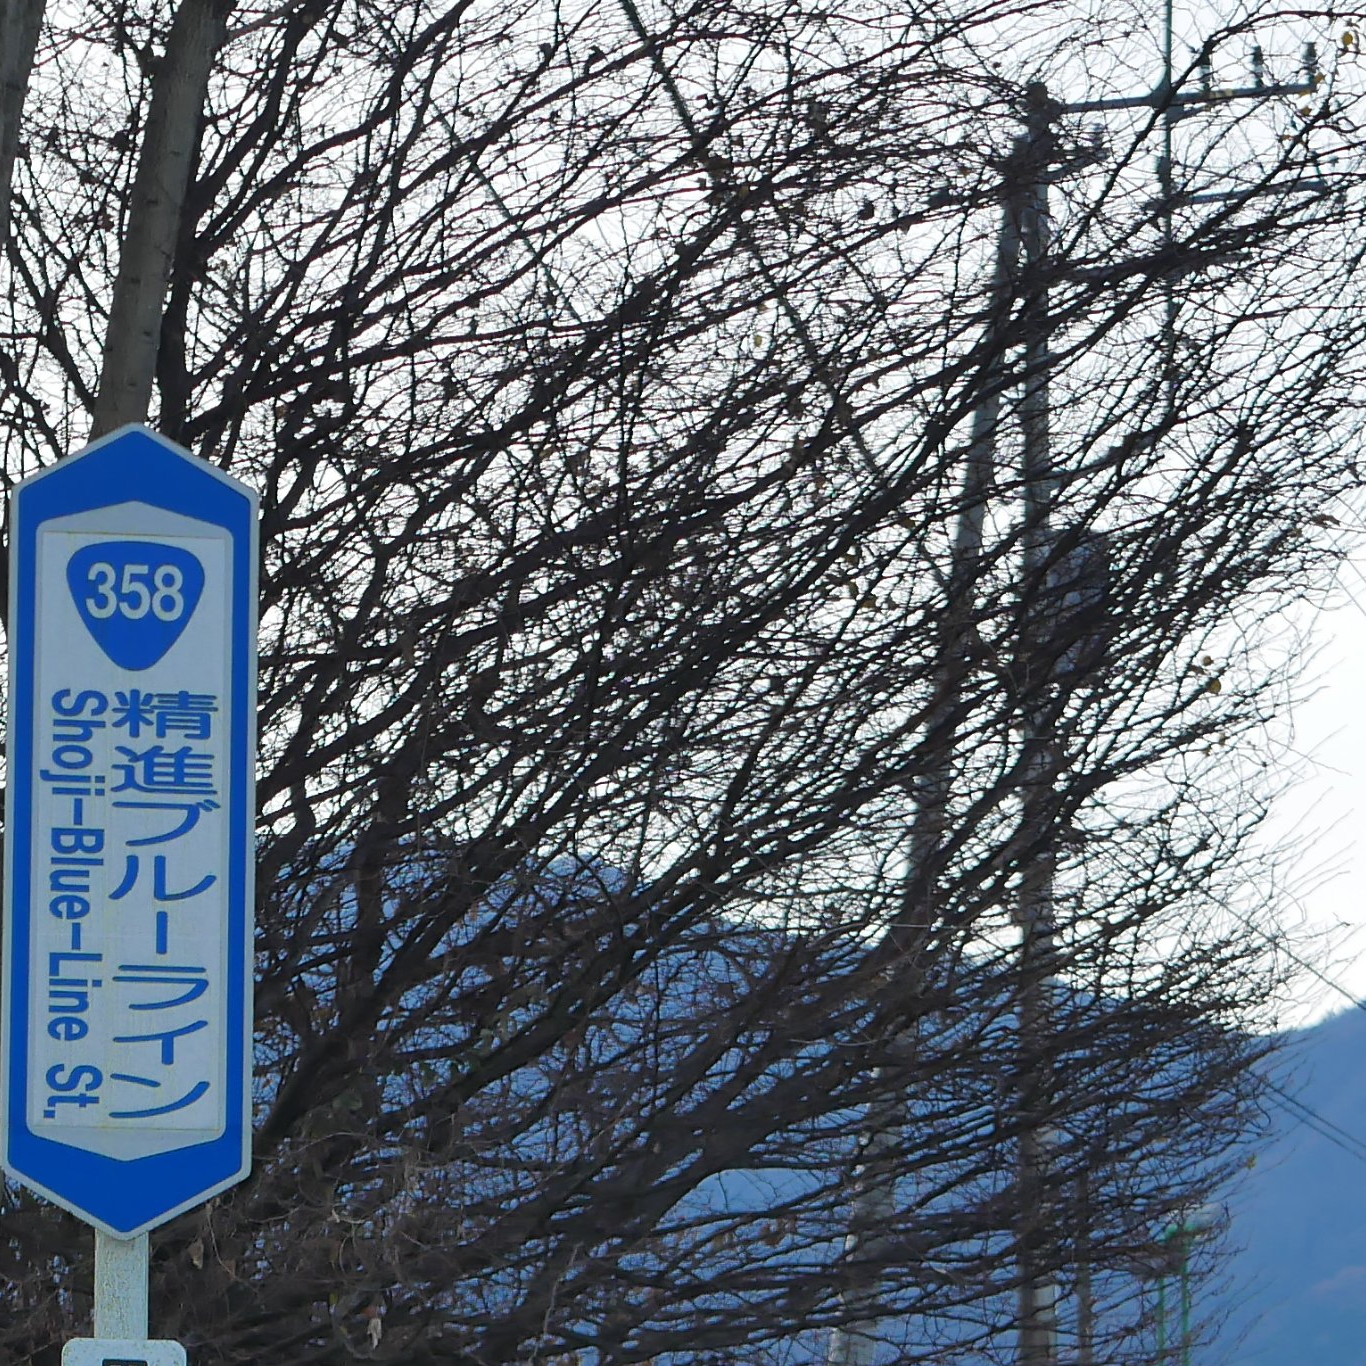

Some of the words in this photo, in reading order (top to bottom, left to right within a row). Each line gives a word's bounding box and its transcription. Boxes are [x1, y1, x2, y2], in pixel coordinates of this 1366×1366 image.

[85, 561, 185, 622] 358
[39, 688, 109, 1041] Shoji-Blue-Line
[108, 688, 220, 1119] 精進ブルーライン
[42, 1063, 104, 1120] St.
